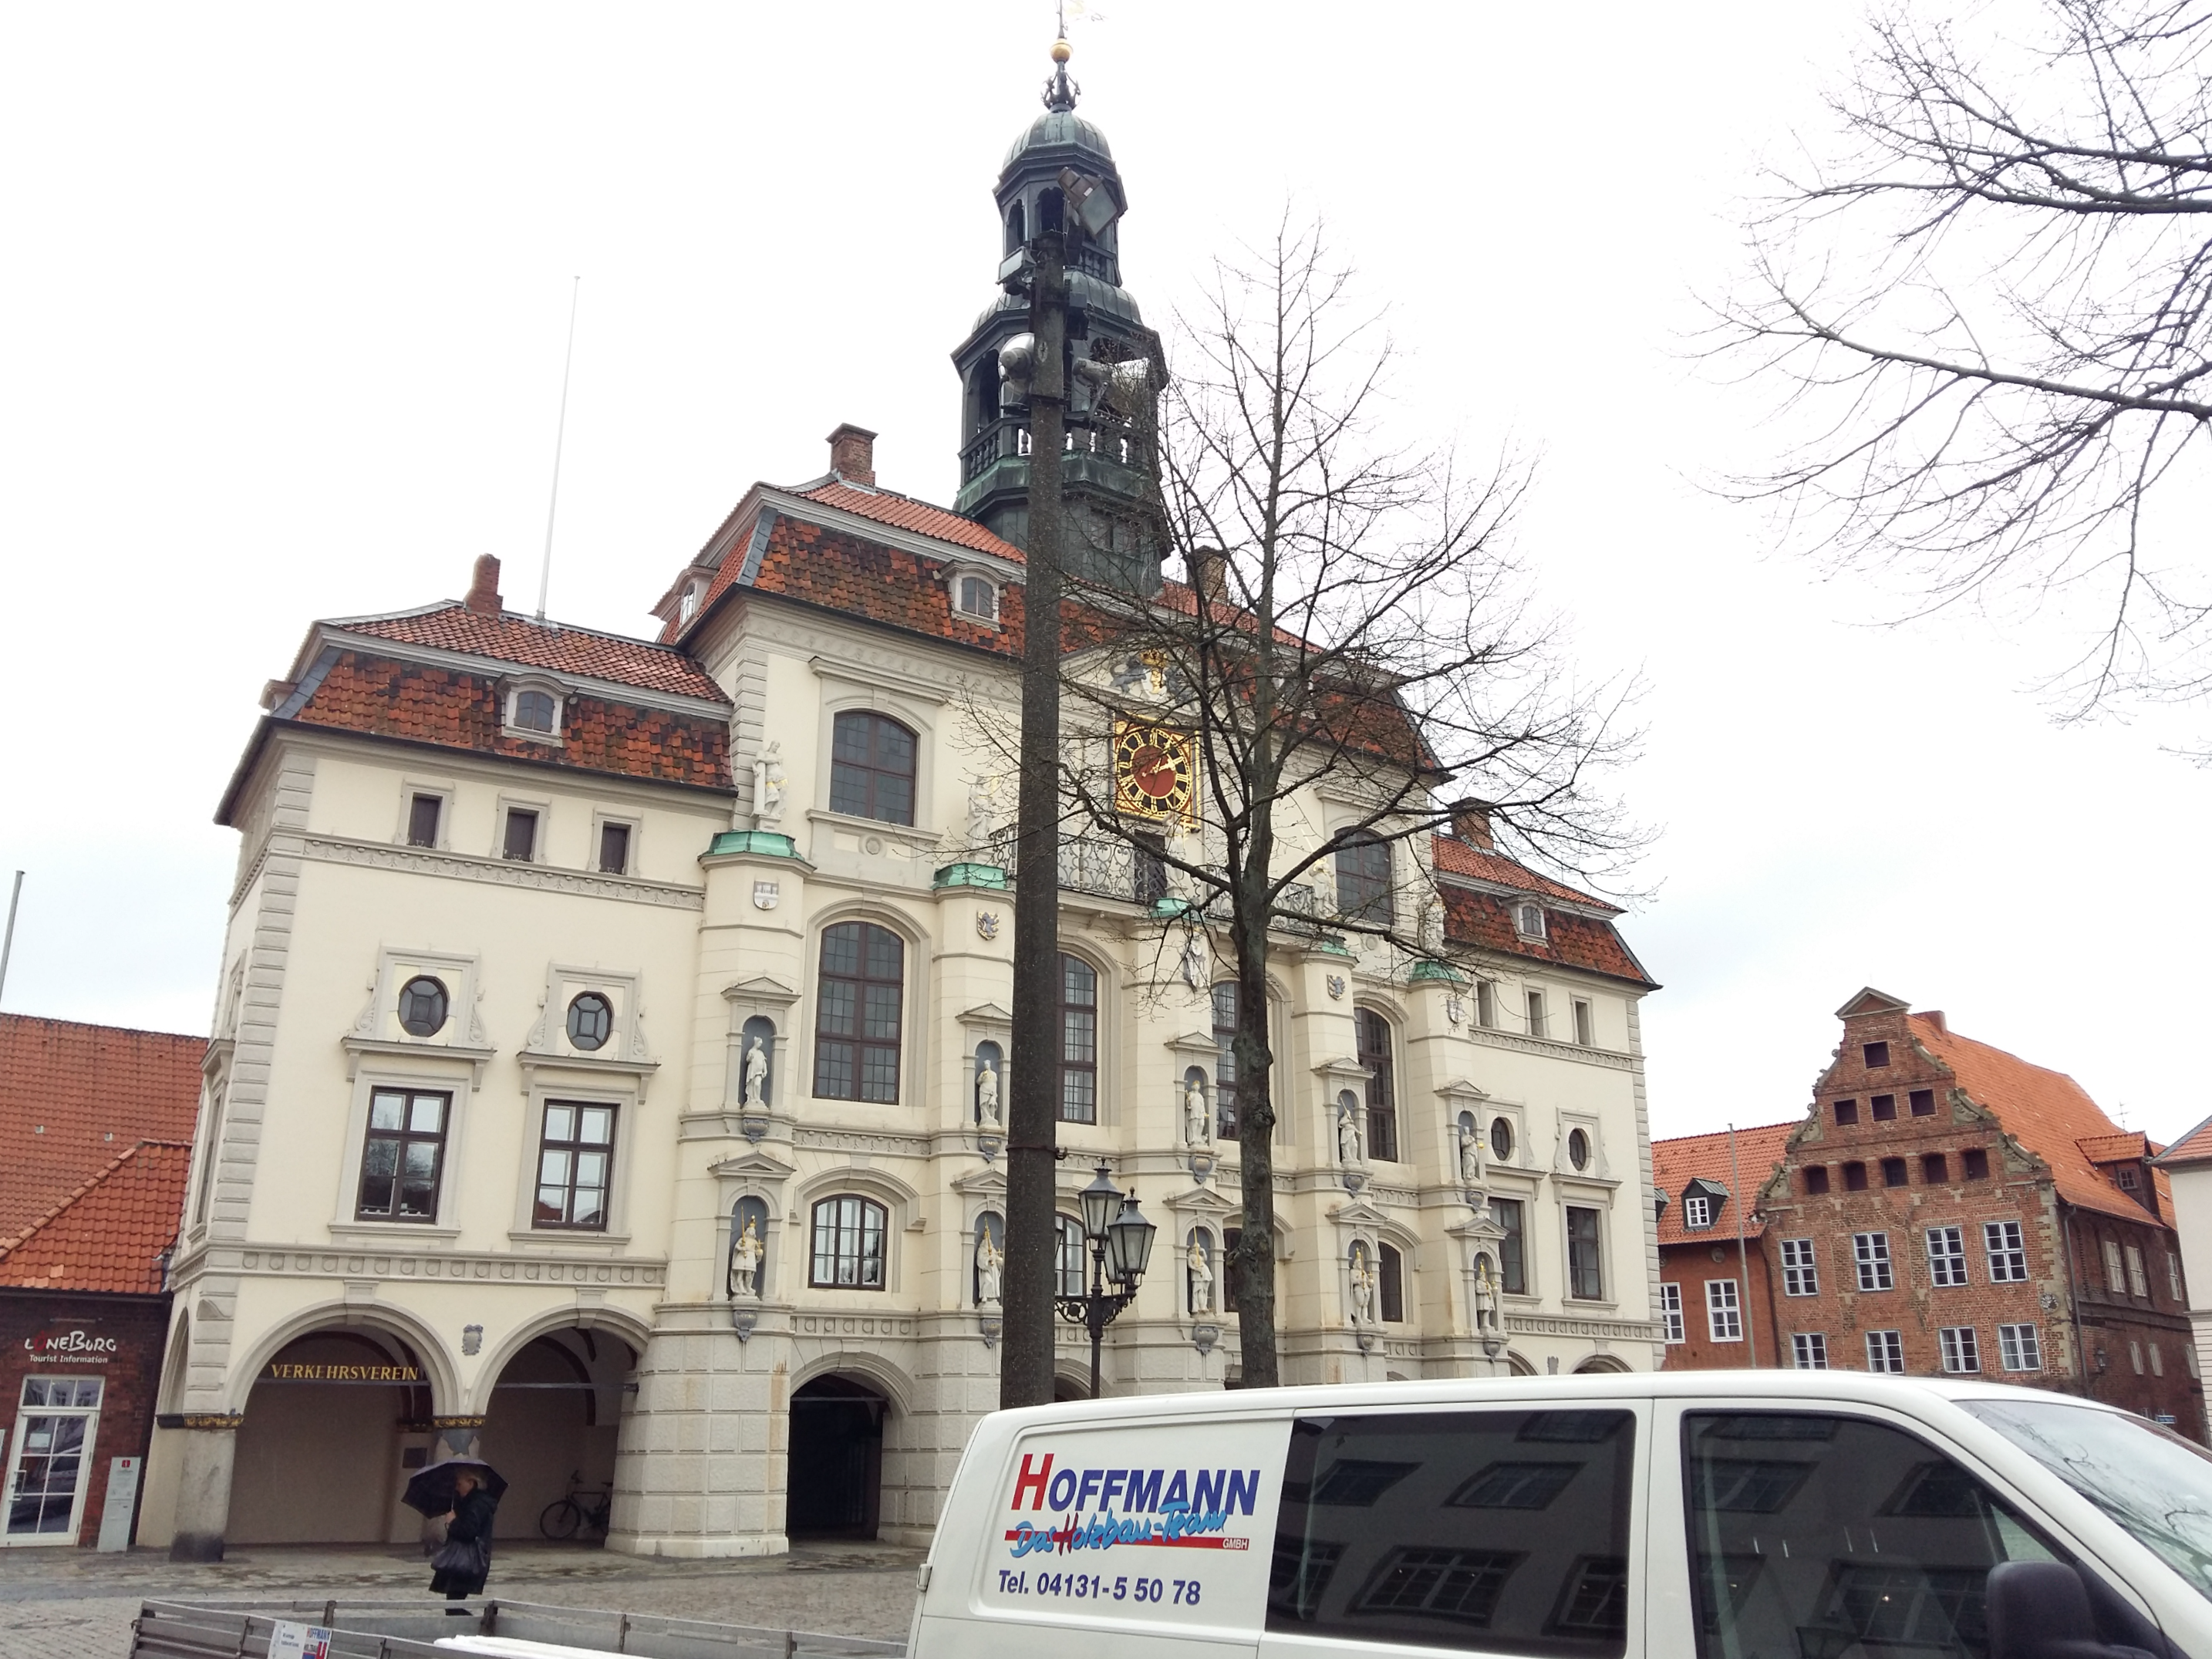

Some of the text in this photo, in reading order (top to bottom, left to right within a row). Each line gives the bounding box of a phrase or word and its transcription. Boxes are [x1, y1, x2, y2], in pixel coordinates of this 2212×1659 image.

[29, 1354, 108, 1364] Tourist Information
[271, 1364, 418, 1381] VERKEHRSVEREIN
[1011, 1453, 1260, 1516] HOFFMANN
[1010, 1502, 1228, 1558] Das Holzbau-Team
[1222, 1538, 1248, 1549] GMBH
[999, 1570, 1029, 1594] Tel.
[1172, 1580, 1201, 1605] 78
